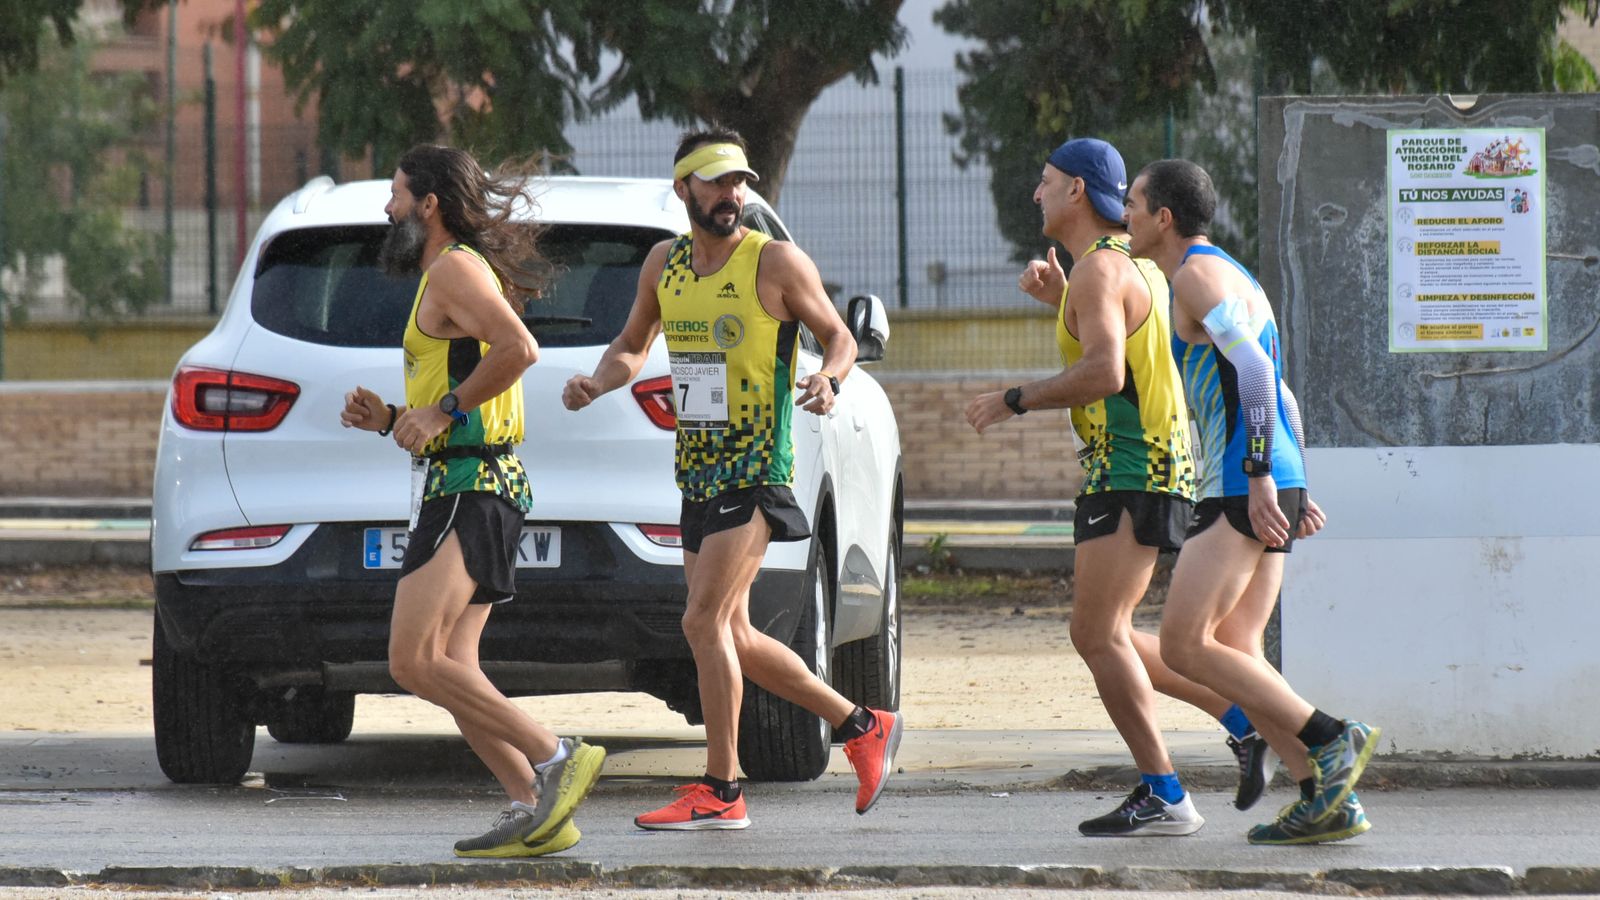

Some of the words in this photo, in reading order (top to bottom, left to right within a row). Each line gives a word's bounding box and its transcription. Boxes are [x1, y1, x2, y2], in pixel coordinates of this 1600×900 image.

[1401, 138, 1445, 146] PARQUE
[1395, 146, 1468, 154] ATRACCIONES
[1442, 154, 1463, 162] DEL
[1408, 163, 1455, 171] ROSARIO
[1401, 188, 1418, 200] TÚ
[1422, 190, 1448, 200] NOS
[1452, 189, 1503, 200] AYUDAS
[1417, 217, 1456, 225] REDUCIR
[1458, 217, 1469, 225] EL
[1471, 217, 1503, 225] AFORO
[1417, 241, 1465, 249] REFORZAR
[1470, 292, 1535, 300] DESINFECCIÓN
[663, 321, 708, 332] UTEROS
[694, 367, 719, 375] JAVIER
[679, 384, 689, 412] 7
[369, 552, 377, 561] E
[391, 533, 407, 562] 5
